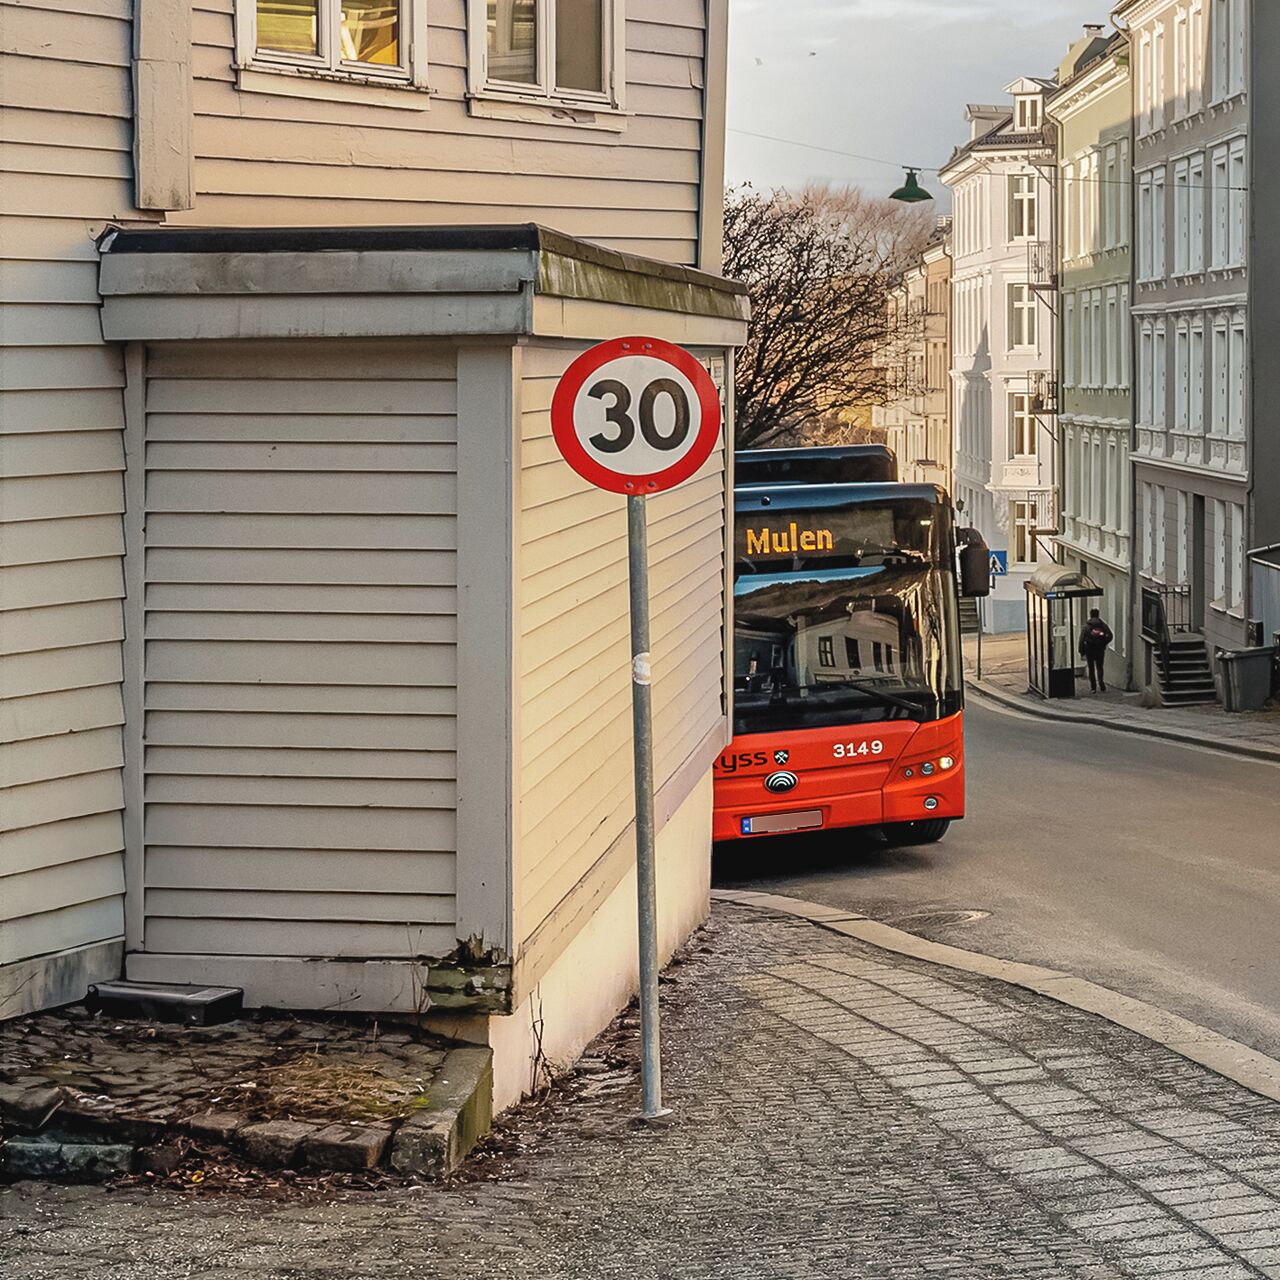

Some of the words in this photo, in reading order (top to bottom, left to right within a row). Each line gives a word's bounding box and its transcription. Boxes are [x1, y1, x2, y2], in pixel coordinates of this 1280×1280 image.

[587, 377, 691, 454] 30
[746, 522, 834, 555] Mulen
[713, 751, 768, 773] yss
[833, 739, 884, 759] 3149
